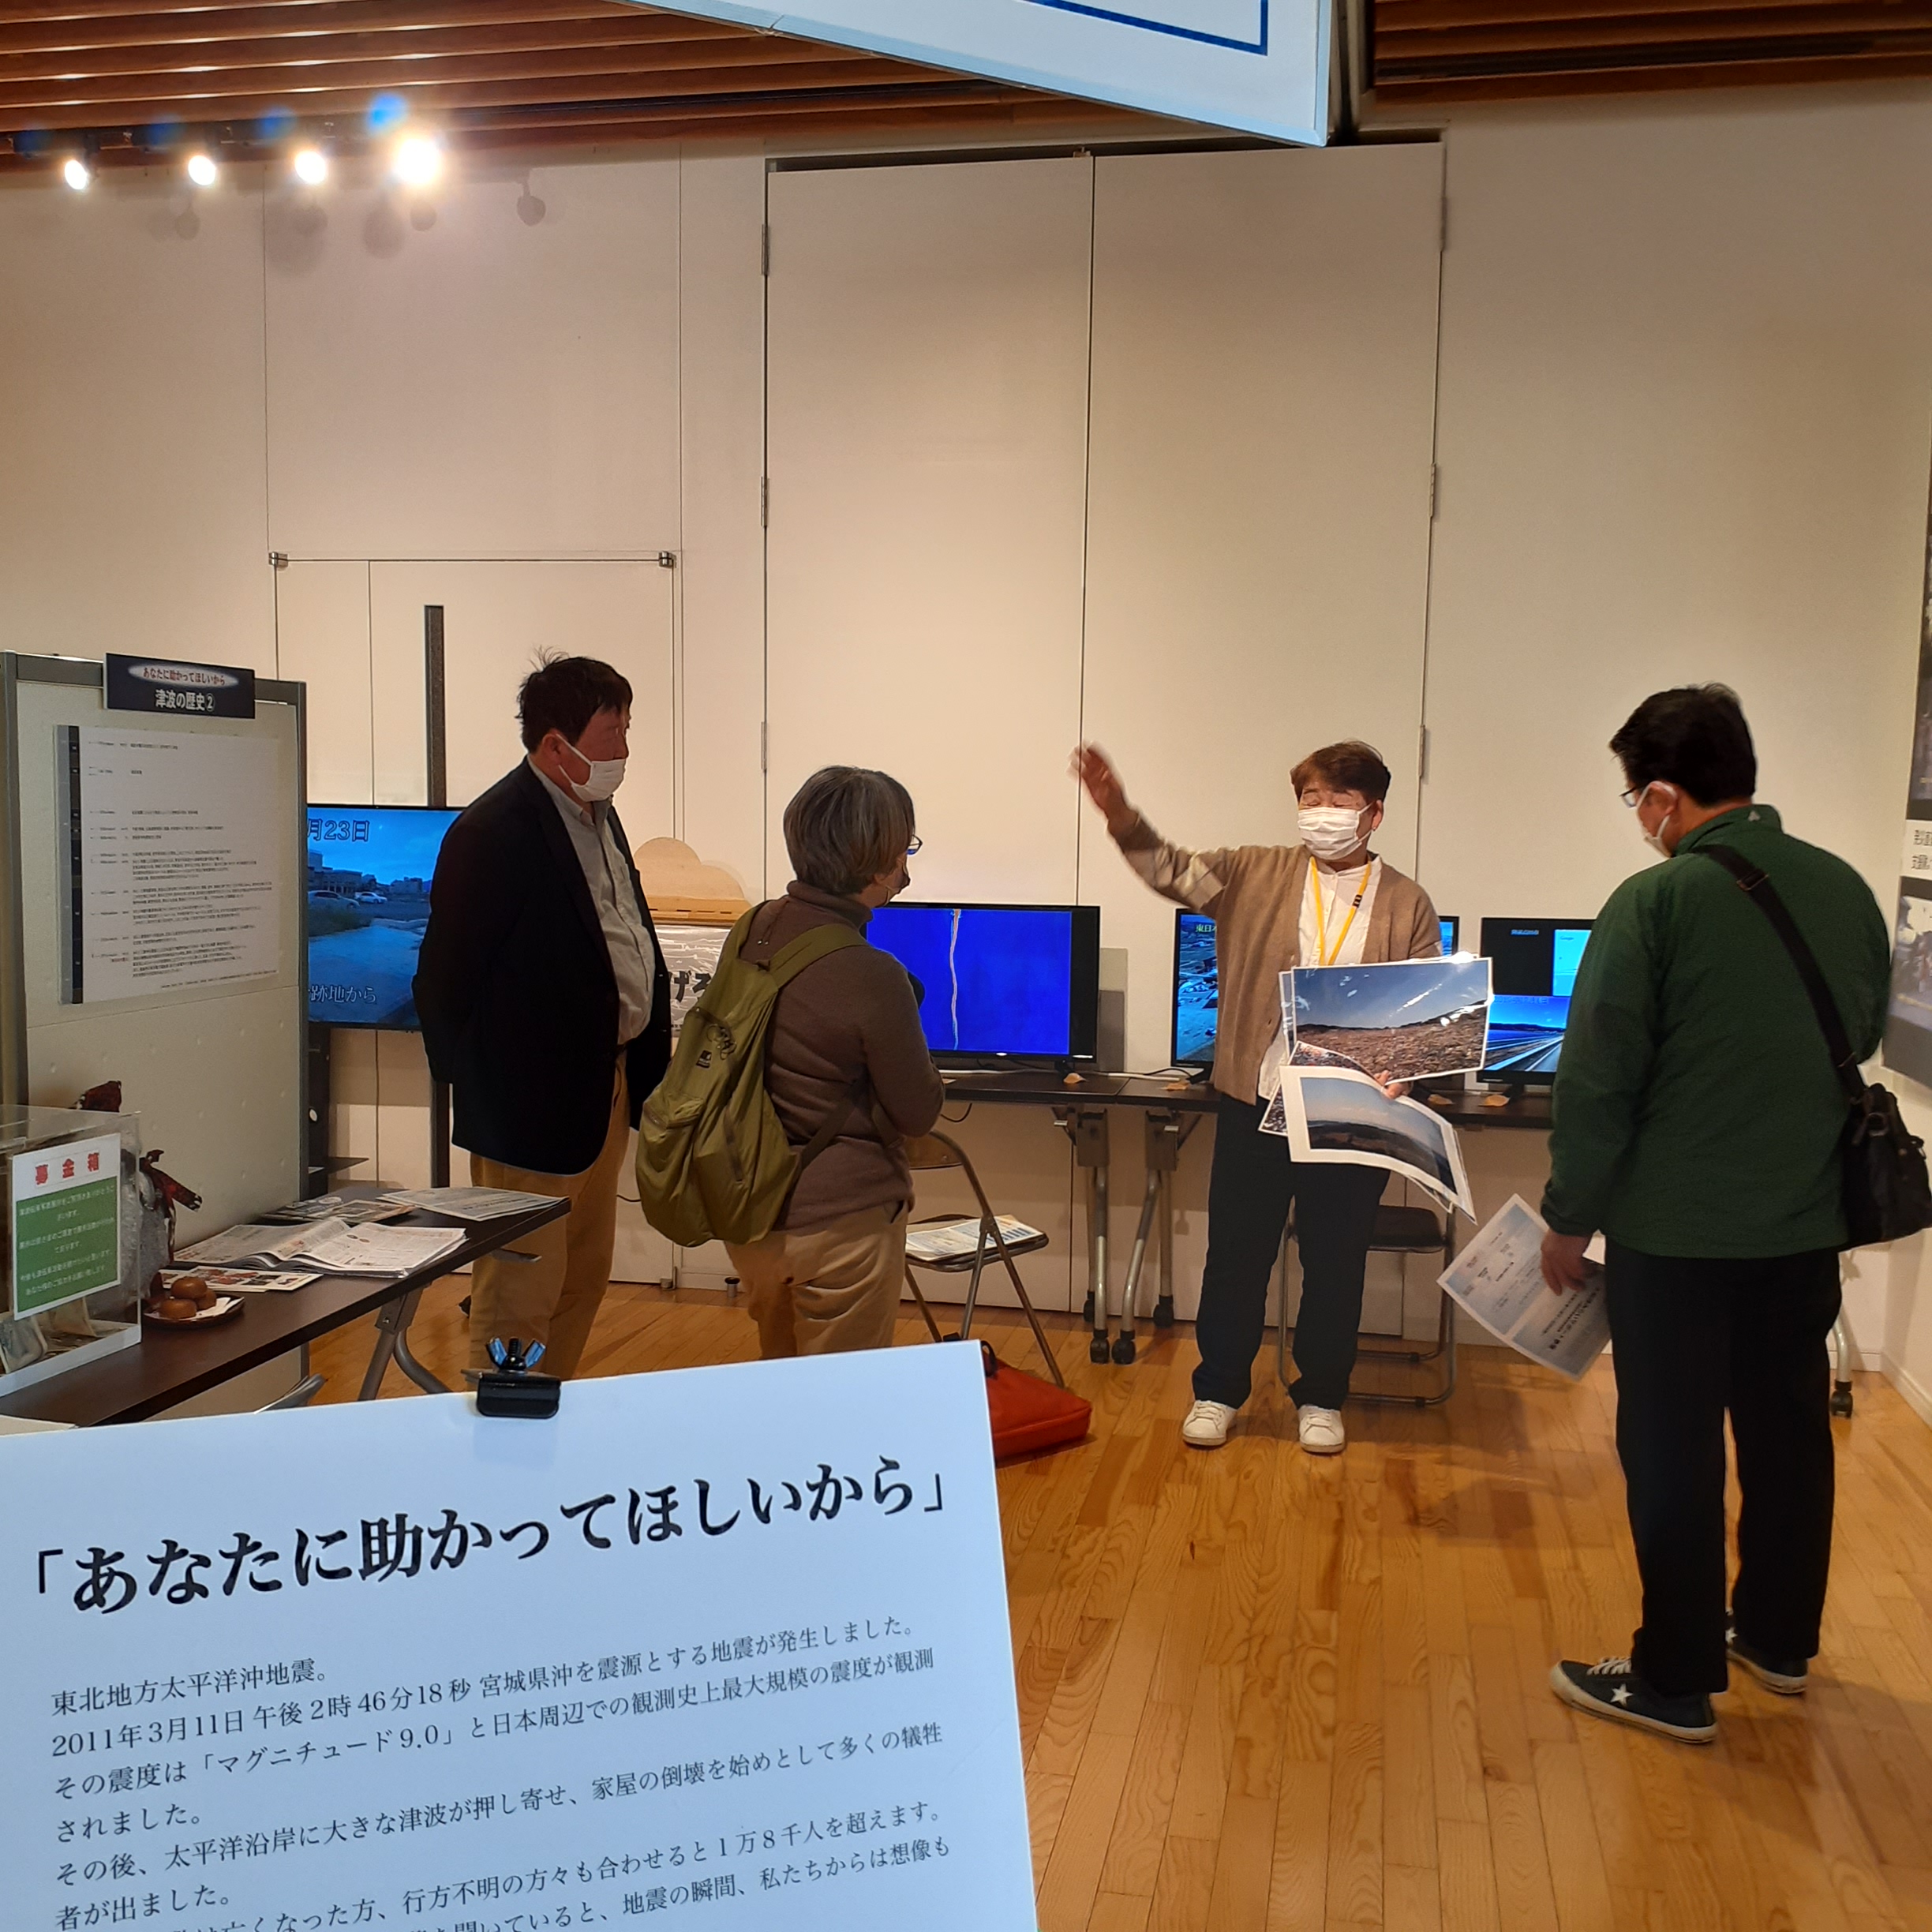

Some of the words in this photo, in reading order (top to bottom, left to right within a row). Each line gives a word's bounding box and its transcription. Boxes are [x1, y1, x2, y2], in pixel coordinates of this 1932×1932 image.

[143, 667, 226, 686] あなたに助かってほしいから
[308, 985, 377, 1003] 跡地から
[38, 1455, 943, 1615] 「あなたに助かってほしいから」
[51, 1657, 327, 1717] 東北地方太平洋沖地震。
[56, 1803, 202, 1845] されました。
[55, 1883, 229, 1931] 者が出ました。
